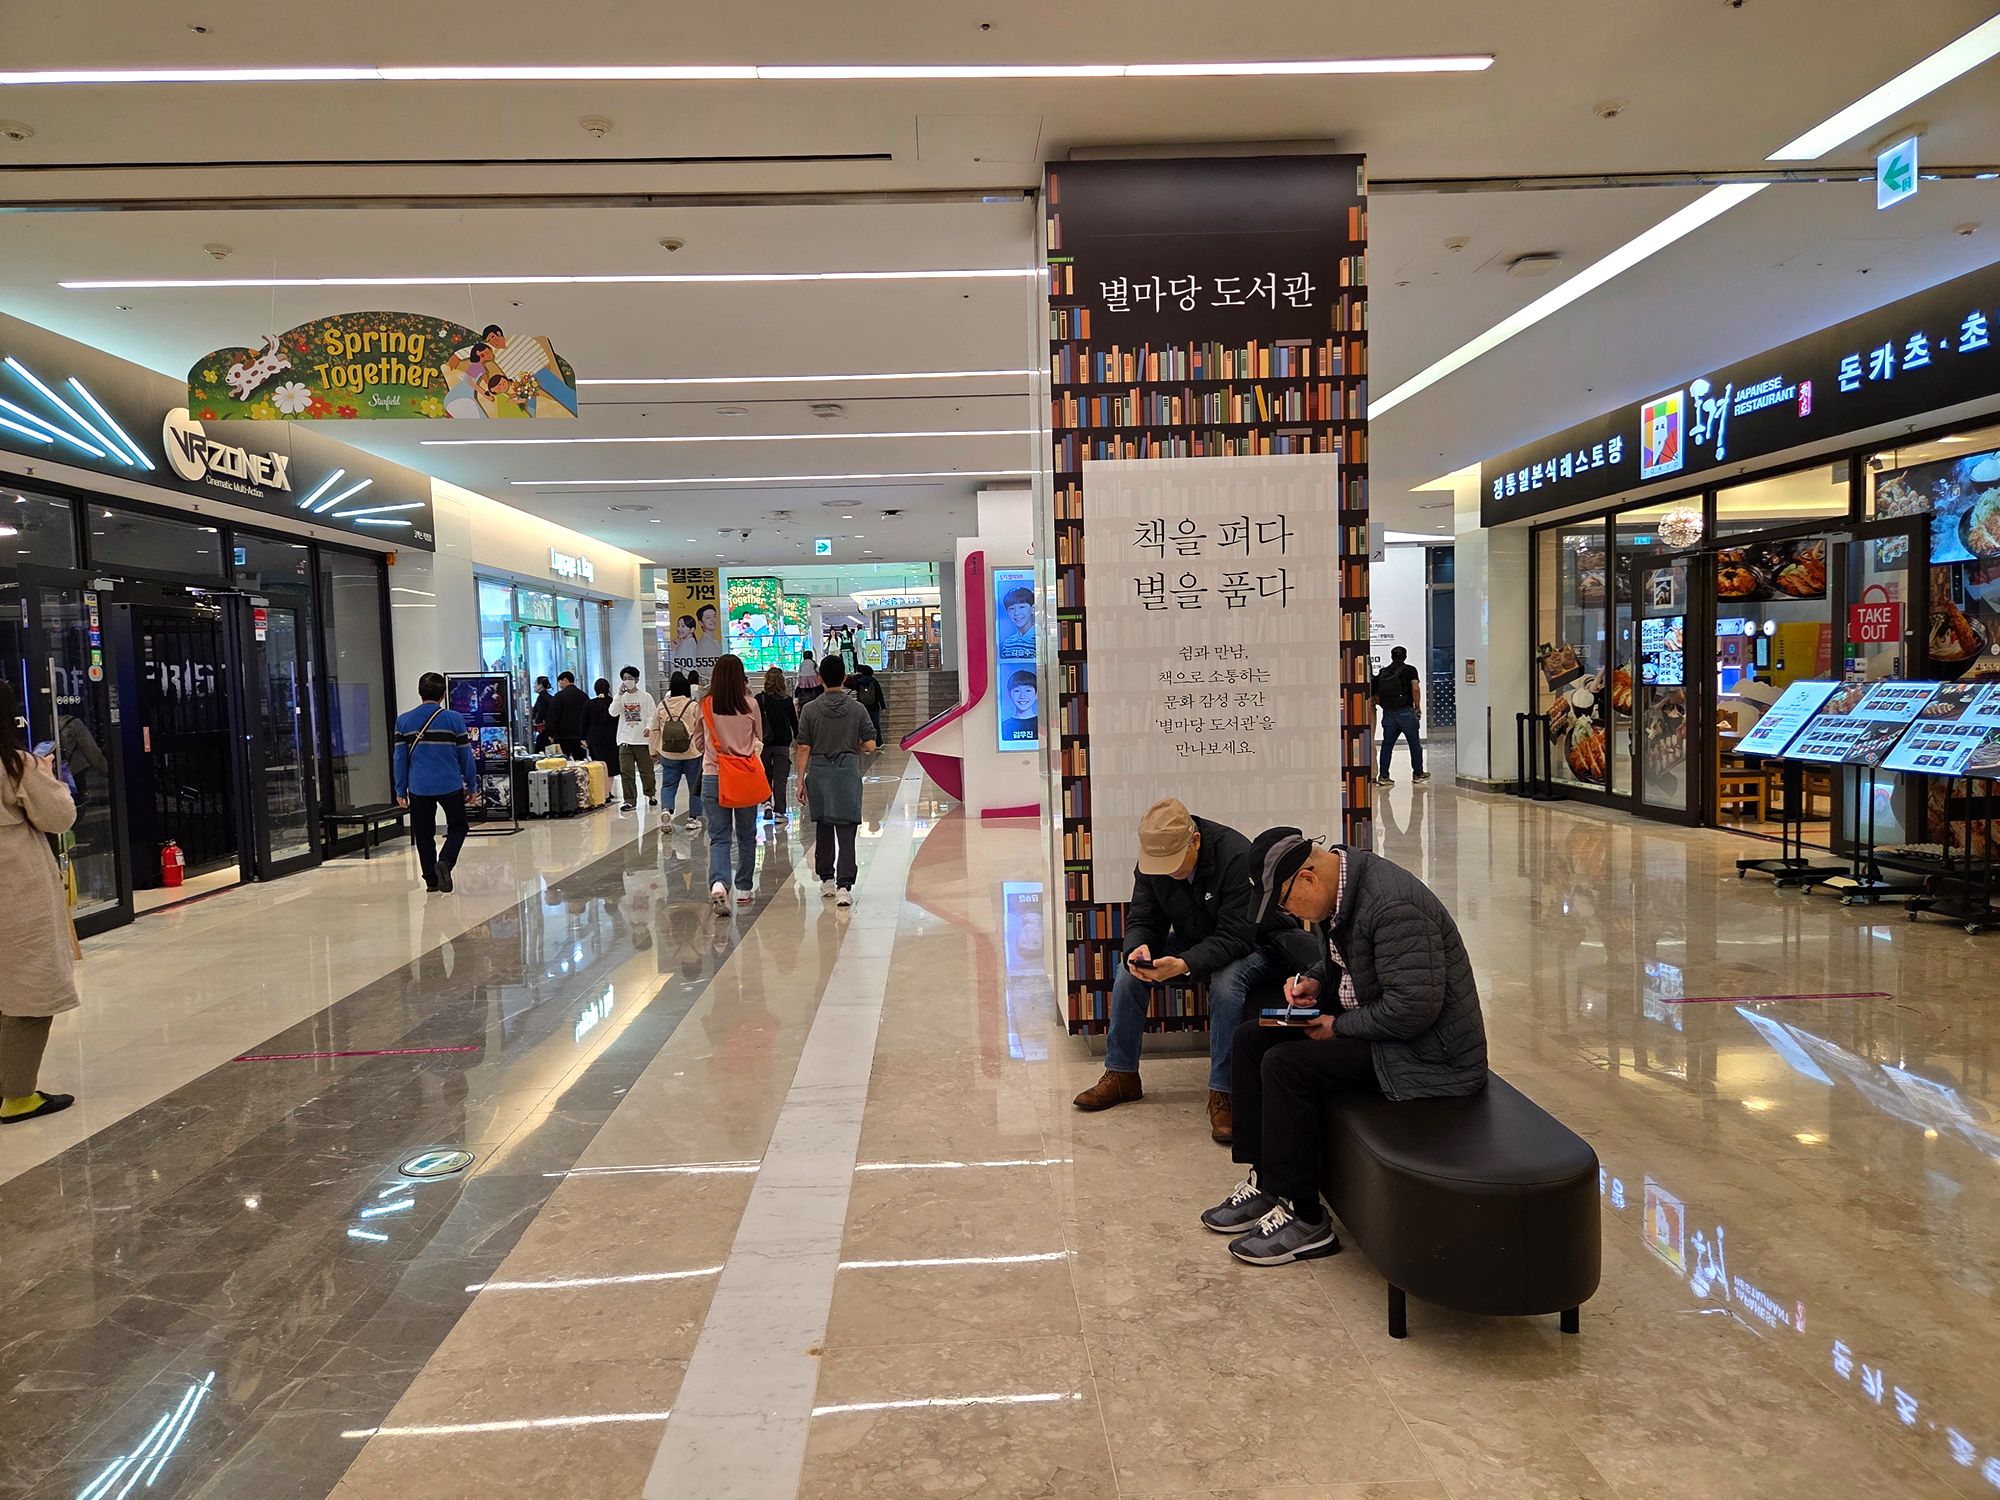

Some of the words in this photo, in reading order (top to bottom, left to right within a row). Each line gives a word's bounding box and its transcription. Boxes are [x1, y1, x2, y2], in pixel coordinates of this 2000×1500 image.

[1099, 275, 1202, 314] 별마당
[1210, 272, 1316, 310] 도서관
[324, 325, 426, 363] Spring
[1838, 311, 2000, 392] 돈카츠·초
[313, 357, 439, 394] Together
[1734, 376, 1783, 403] JAPANESE
[1734, 384, 1797, 416] RESTAURANT
[1643, 462, 1678, 475] TOKYO
[206, 475, 234, 491] Cinematic
[233, 481, 264, 498] Multi-Action
[1132, 517, 1208, 559] 책을
[1217, 514, 1294, 556] 펴다
[671, 567, 714, 583] 결혼은
[686, 585, 715, 600] 가연
[729, 585, 763, 596] Spring
[1133, 571, 1209, 611] 별을
[1217, 567, 1295, 610] 품다
[1857, 607, 1892, 623] TAKE
[1860, 624, 1888, 640] OUT
[1178, 646, 1210, 661] 쉼과
[1214, 644, 1249, 660] 만남,
[1158, 670, 1205, 685] 책으로
[1208, 668, 1270, 684] 소통하는
[1163, 694, 1195, 709] 문화
[1199, 692, 1229, 708] 감성
[1234, 691, 1265, 707] 공간
[1175, 740, 1256, 757] 만나보세요.
